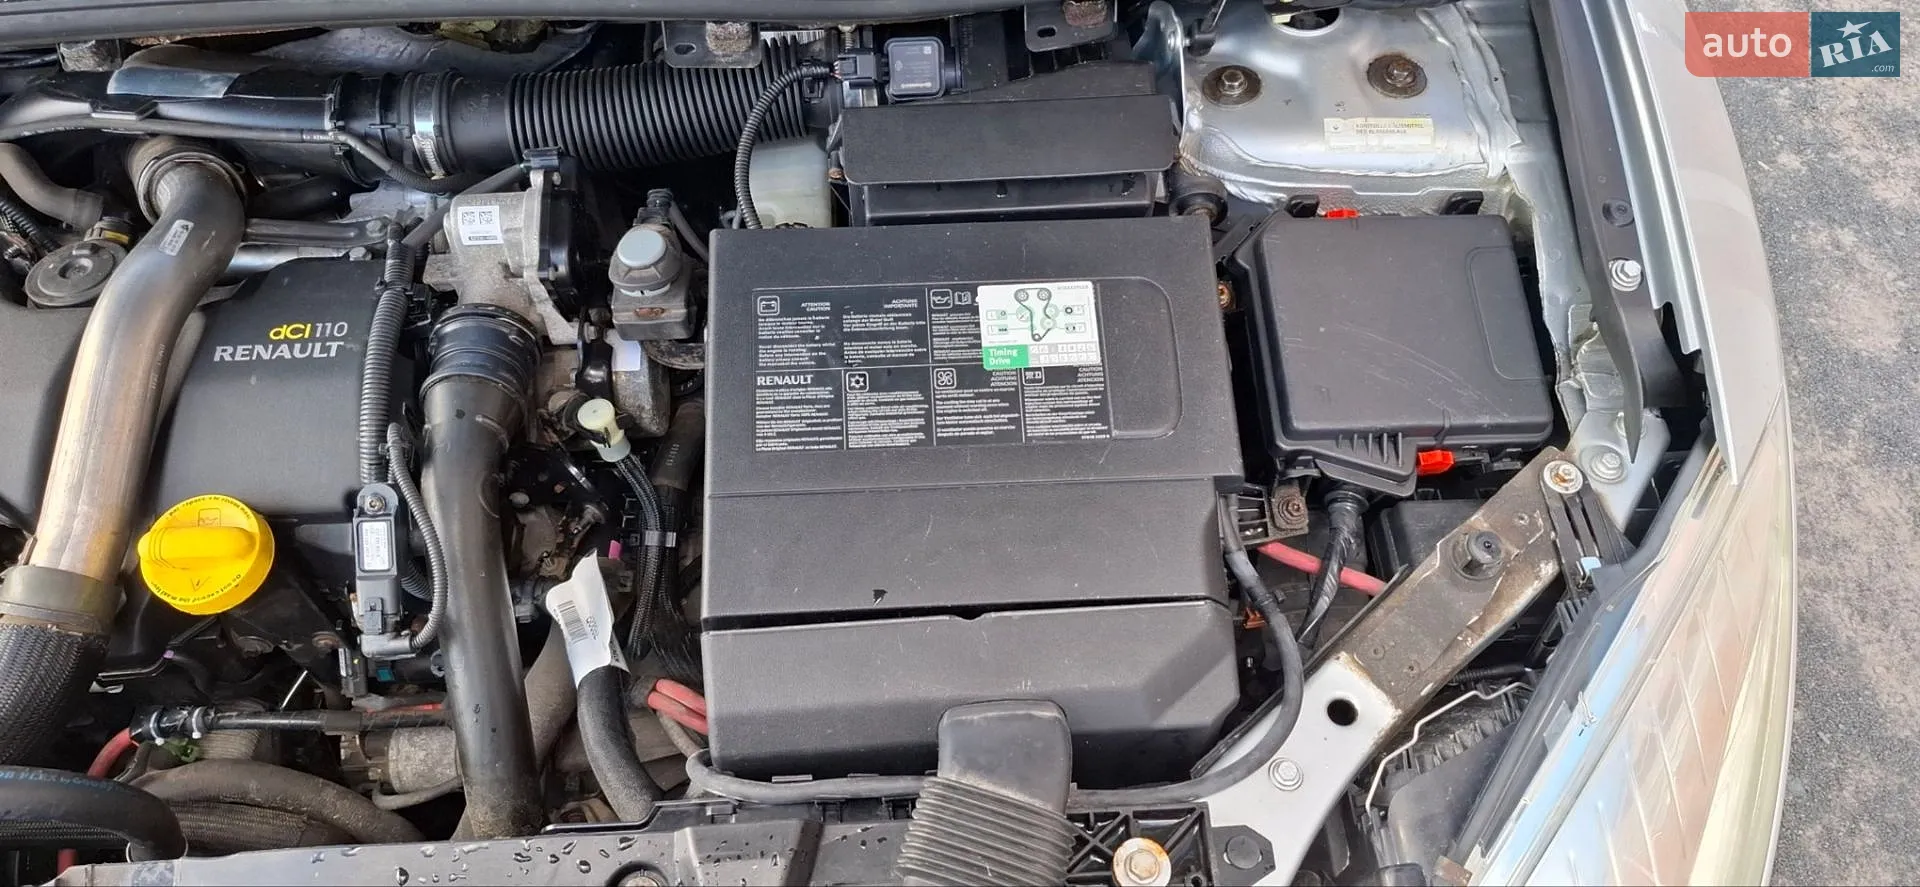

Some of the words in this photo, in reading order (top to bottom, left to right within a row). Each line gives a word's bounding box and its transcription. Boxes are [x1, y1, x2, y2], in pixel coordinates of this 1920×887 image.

[315, 321, 348, 338] 110
[213, 341, 344, 362] RENAULT
[989, 349, 1018, 357] Timing
[989, 357, 1011, 366] Drive
[757, 375, 814, 386] RENAULT
